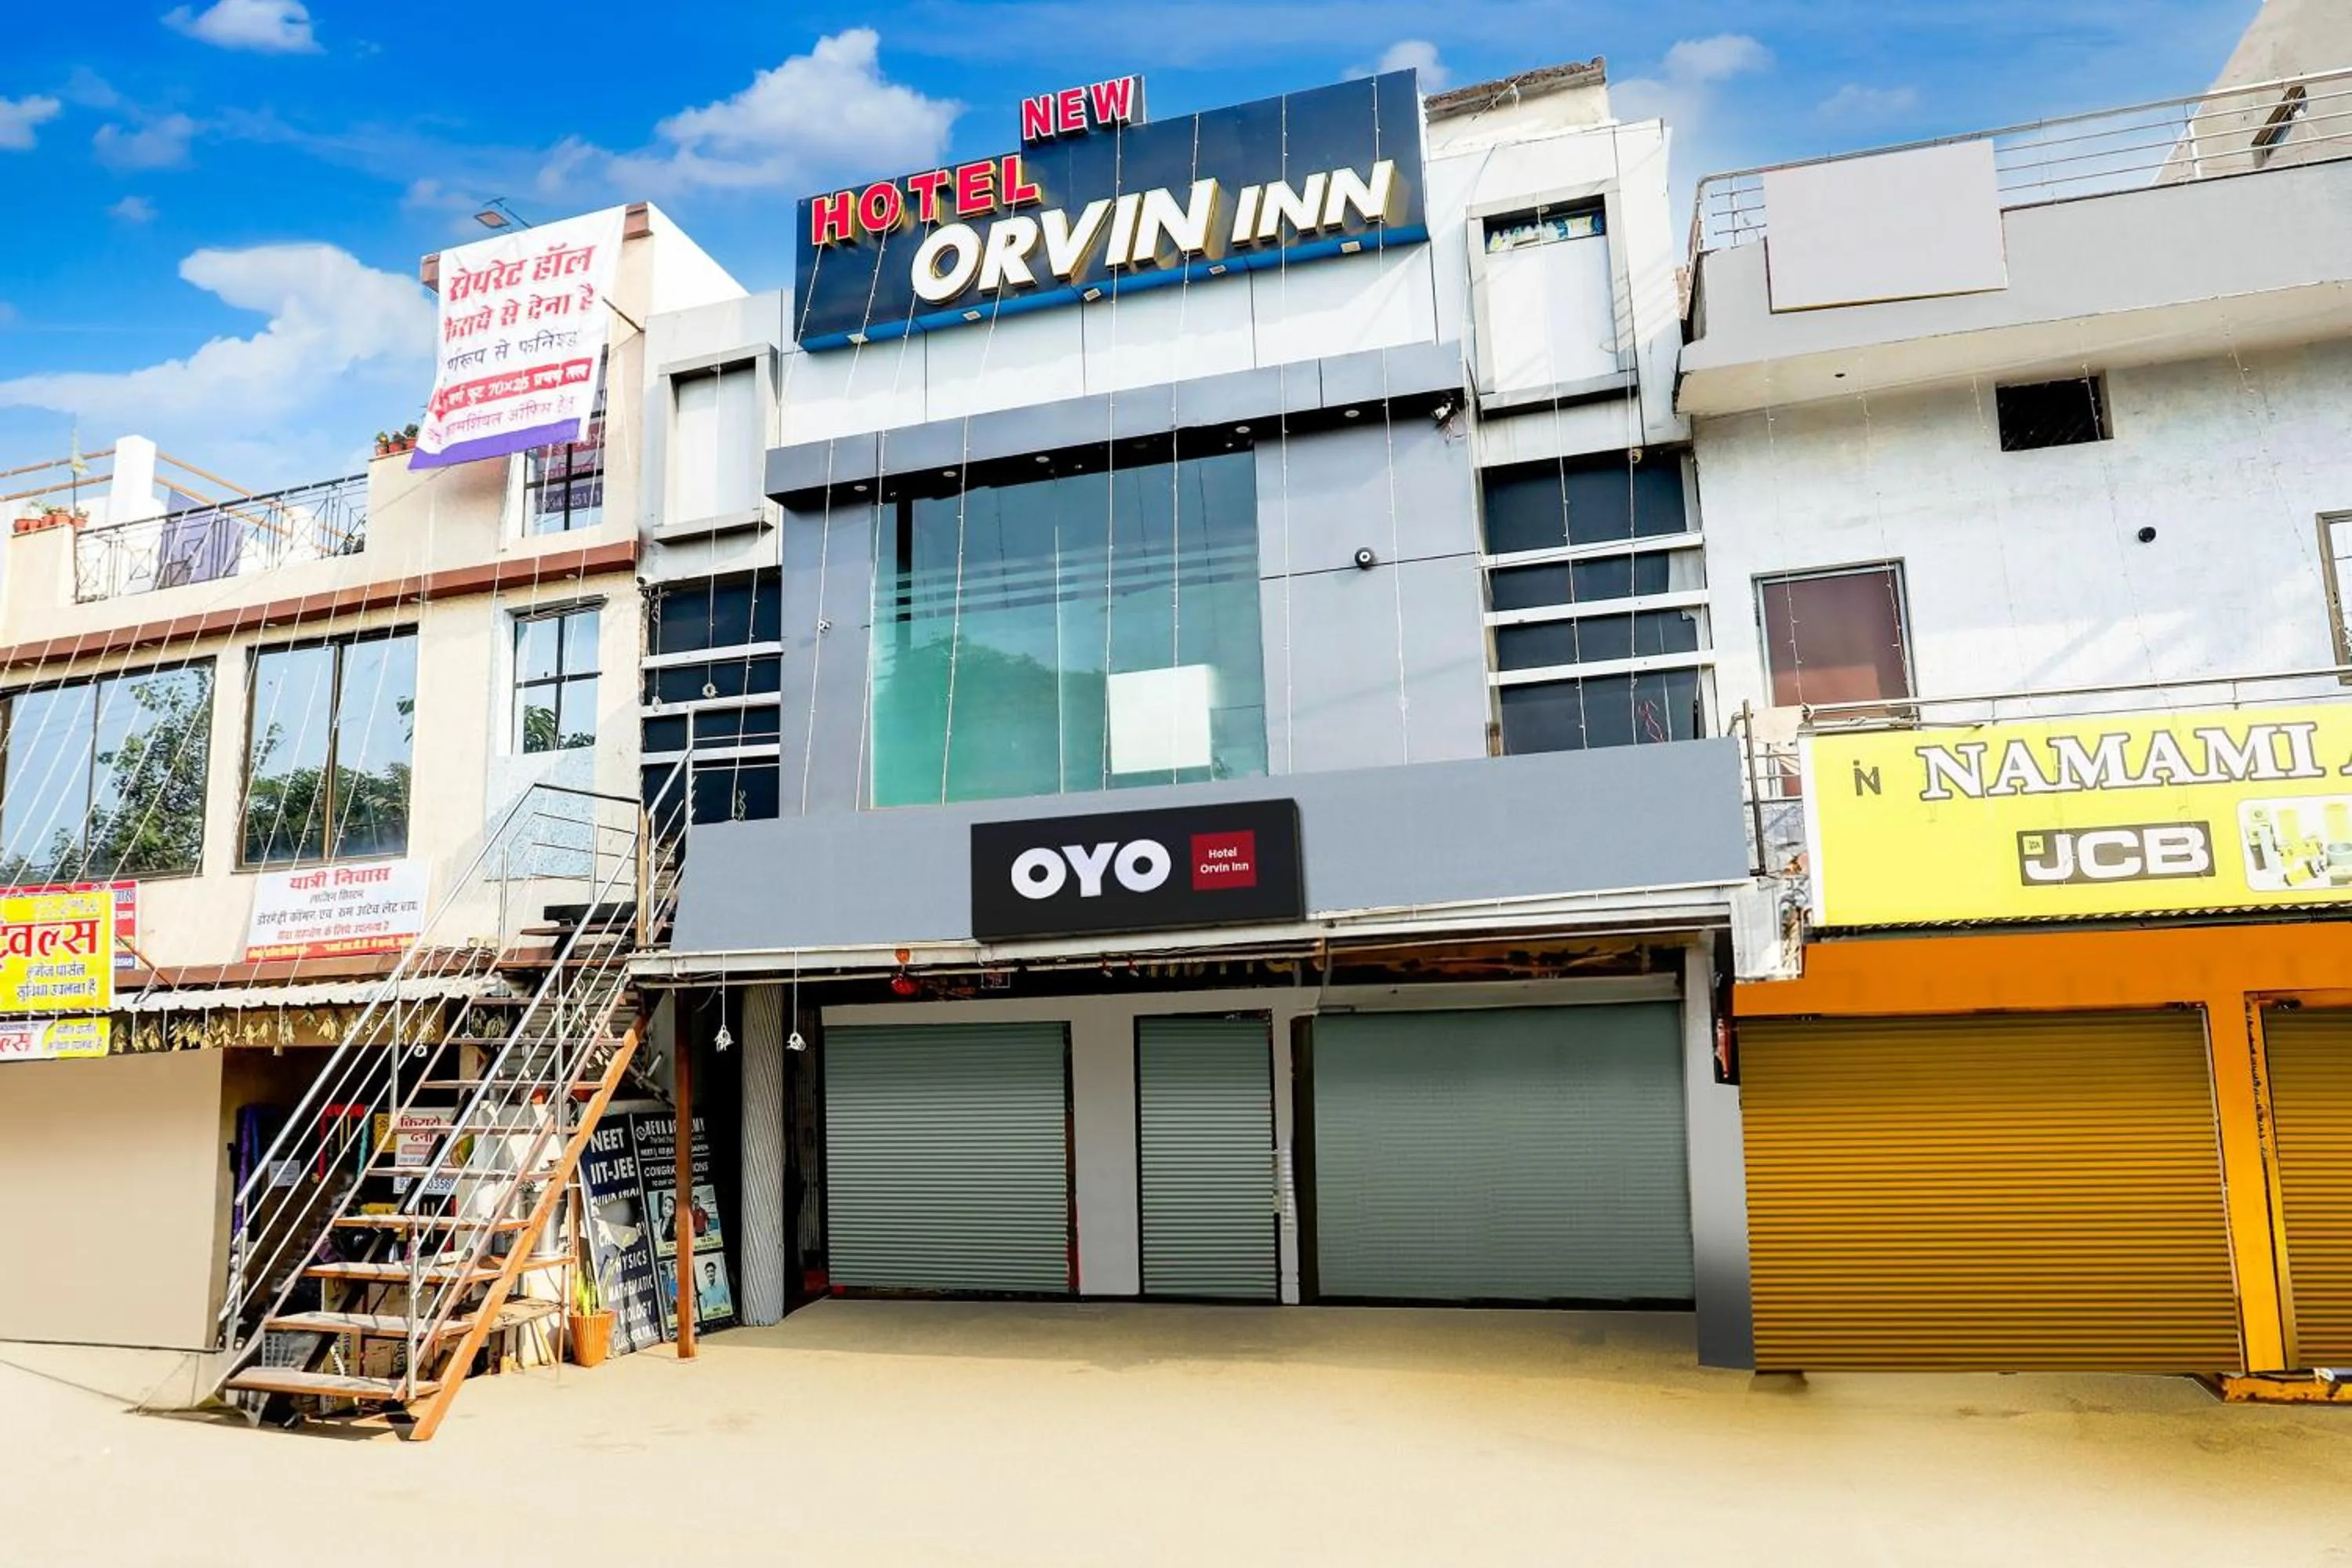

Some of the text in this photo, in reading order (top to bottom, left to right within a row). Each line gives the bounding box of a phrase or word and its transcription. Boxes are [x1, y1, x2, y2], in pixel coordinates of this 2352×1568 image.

[1021, 77, 1137, 141] NEW
[811, 155, 1042, 246] HOTEL
[912, 159, 1396, 306] ORVIN INN
[532, 242, 597, 281] हॉल
[527, 293, 570, 320] देना
[494, 338, 511, 360] से
[1915, 721, 2327, 801] NAMAMI
[1011, 838, 1172, 900] OYO
[1200, 862, 1249, 875] Orvin Inn
[1208, 847, 1237, 859] Hotel
[2024, 827, 2209, 881] JCB
[289, 866, 391, 890] यात्री निवास
[590, 1127, 624, 1153] NEET
[590, 1156, 636, 1185] IIT-JEE
